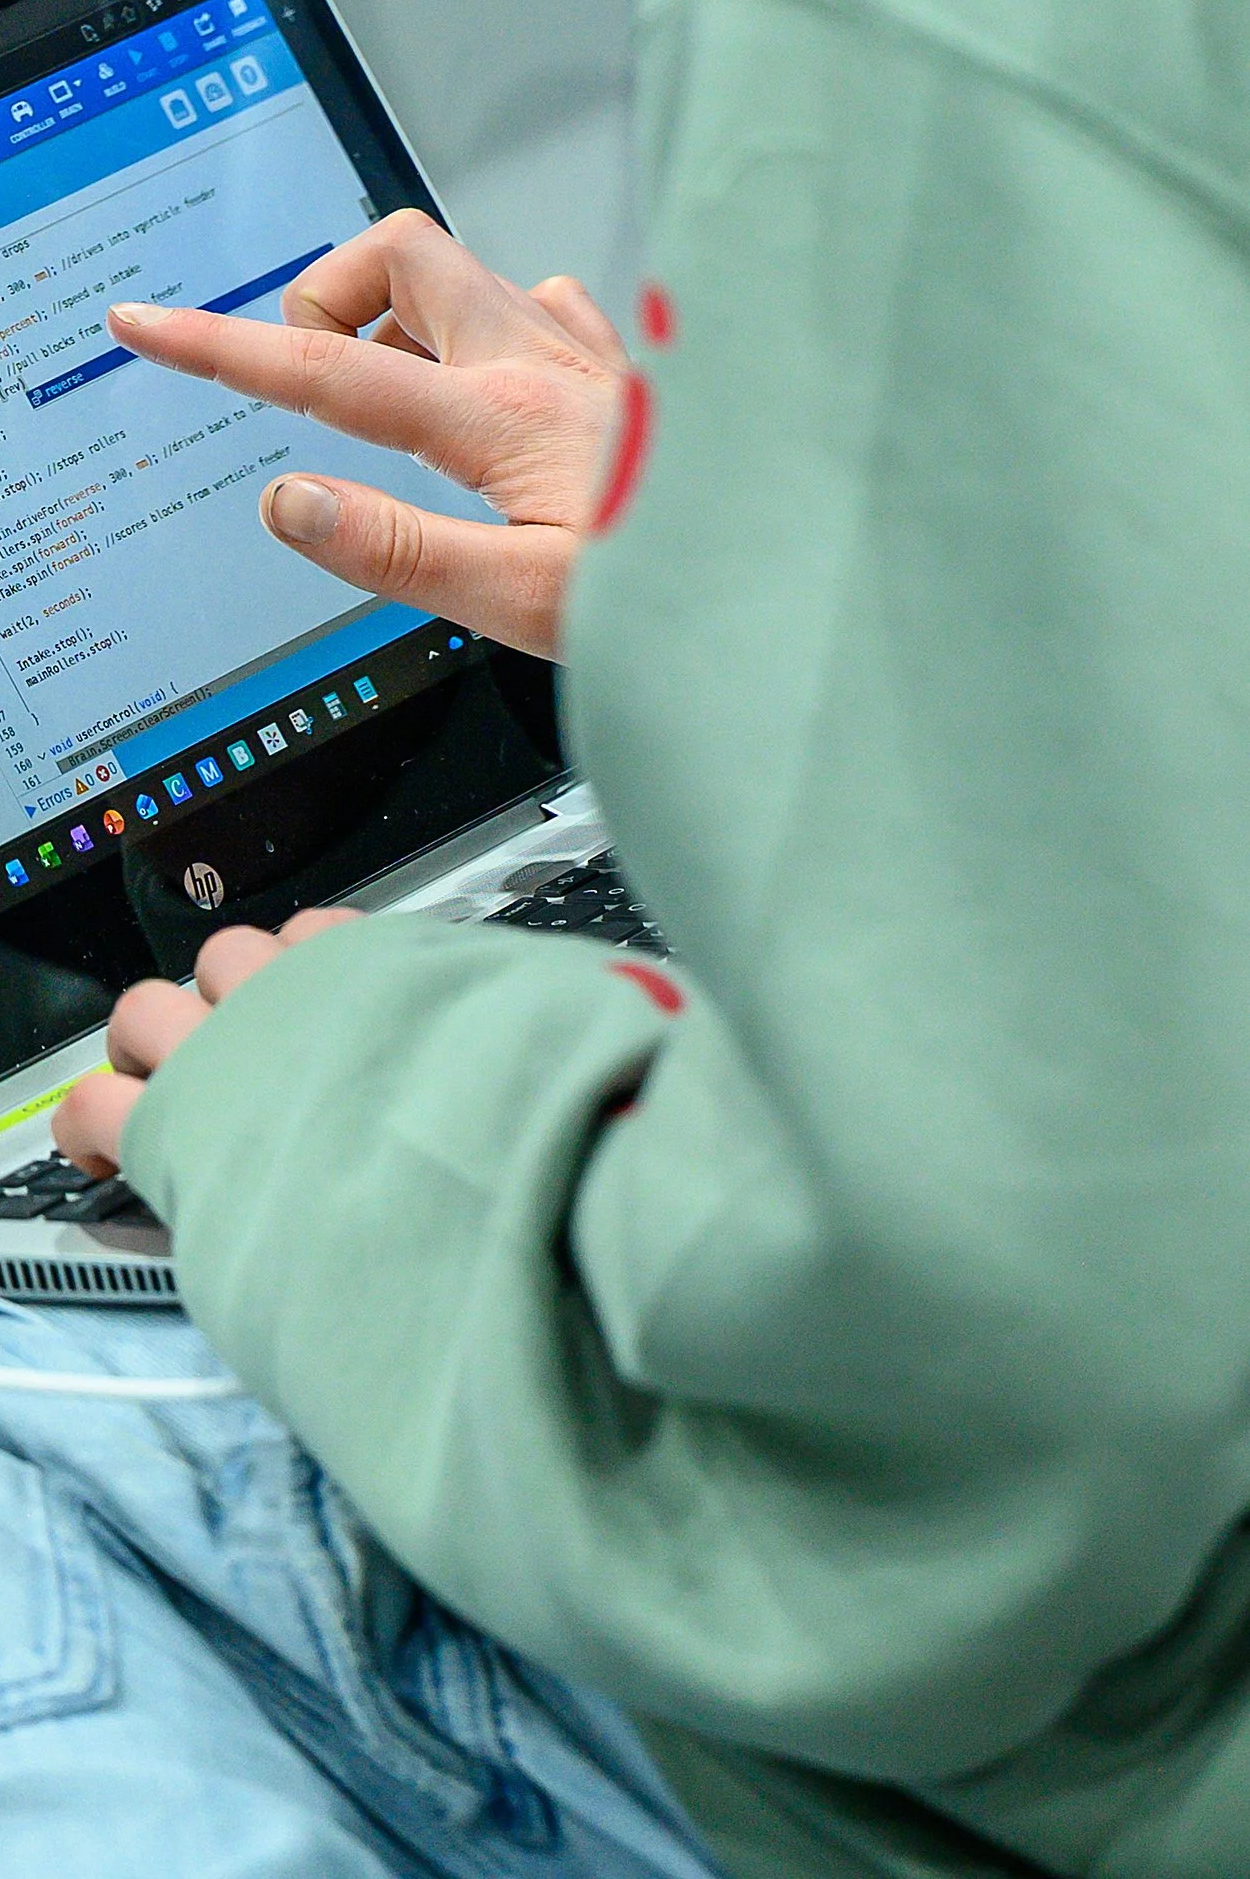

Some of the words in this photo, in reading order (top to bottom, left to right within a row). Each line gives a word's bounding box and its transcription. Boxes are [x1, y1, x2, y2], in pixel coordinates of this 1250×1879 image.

[0, 238, 31, 260] drops
[7, 279, 30, 294] 300,
[61, 243, 103, 270] //drives
[52, 287, 89, 314] //speed
[92, 280, 106, 293] up
[109, 265, 141, 284] intake
[7, 352, 38, 376] //pull
[41, 336, 75, 357] blocks
[78, 323, 102, 338] from
[45, 372, 83, 396] reverse
[47, 451, 84, 476] //stops
[88, 430, 125, 453] rollers
[108, 467, 132, 483] 300,
[163, 430, 204, 458] //drives
[206, 417, 231, 433] back
[233, 410, 246, 420] to
[105, 519, 147, 547] //scores
[149, 501, 183, 522] blocks
[186, 487, 210, 503] from
[0, 615, 38, 638] wait(2,
[43, 588, 91, 617] seconds);
[16, 628, 92, 670] Intake.stop();
[26, 630, 127, 686] mainRollers.stop();
[5, 742, 23, 758] 159
[13, 758, 32, 773] 160
[49, 736, 73, 755] void
[76, 688, 165, 741] userControl(void)
[200, 762, 218, 781] M
[232, 746, 248, 764] B
[22, 774, 41, 789] 161
[37, 787, 72, 811] Errors
[84, 773, 95, 787] 0
[107, 761, 117, 774] 0
[171, 779, 186, 797] C
[186, 863, 221, 910] hp
